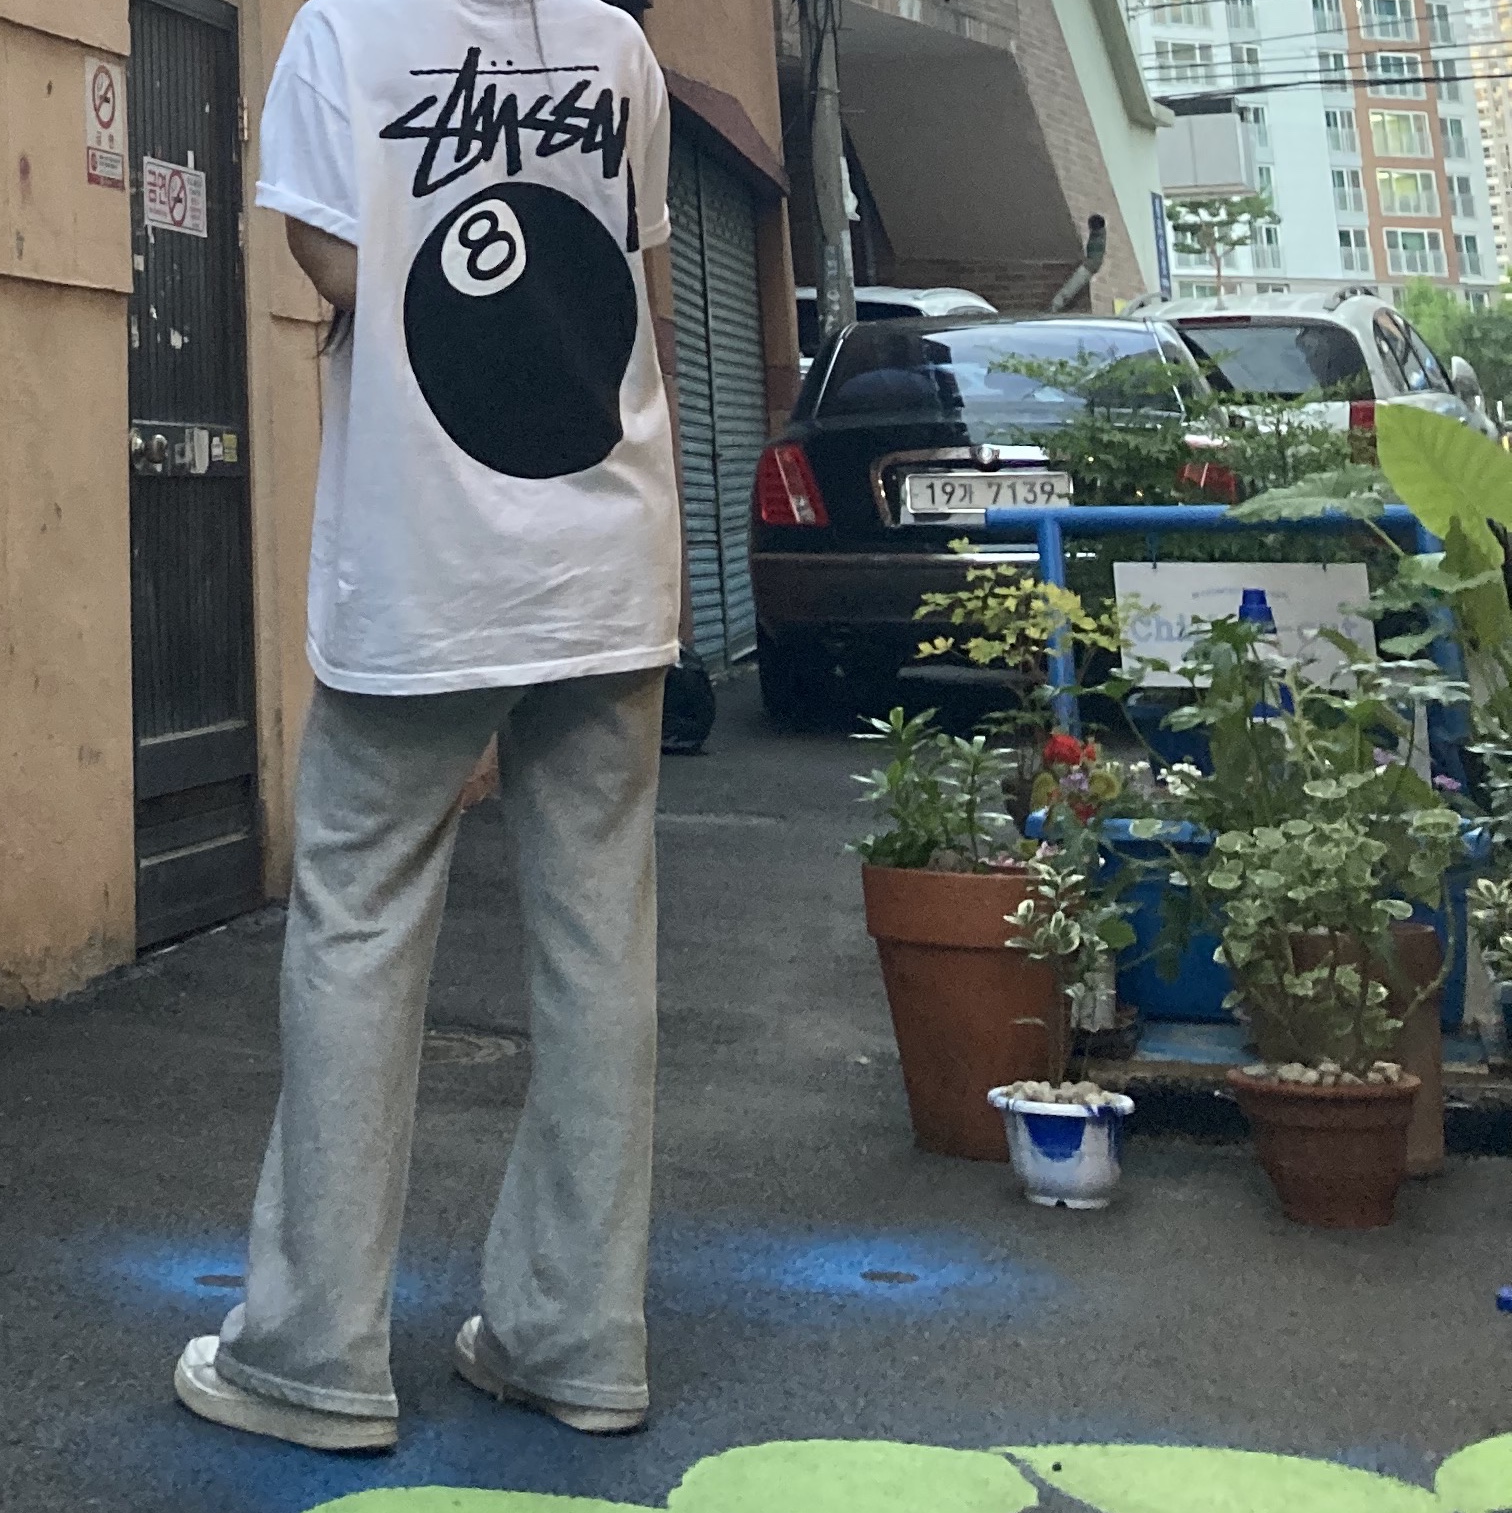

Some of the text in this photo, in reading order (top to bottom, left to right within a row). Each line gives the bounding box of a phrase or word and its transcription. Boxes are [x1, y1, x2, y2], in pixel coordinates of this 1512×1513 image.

[147, 169, 168, 207] 금연
[458, 210, 516, 281] 8
[926, 481, 1055, 505] 19가 7139
